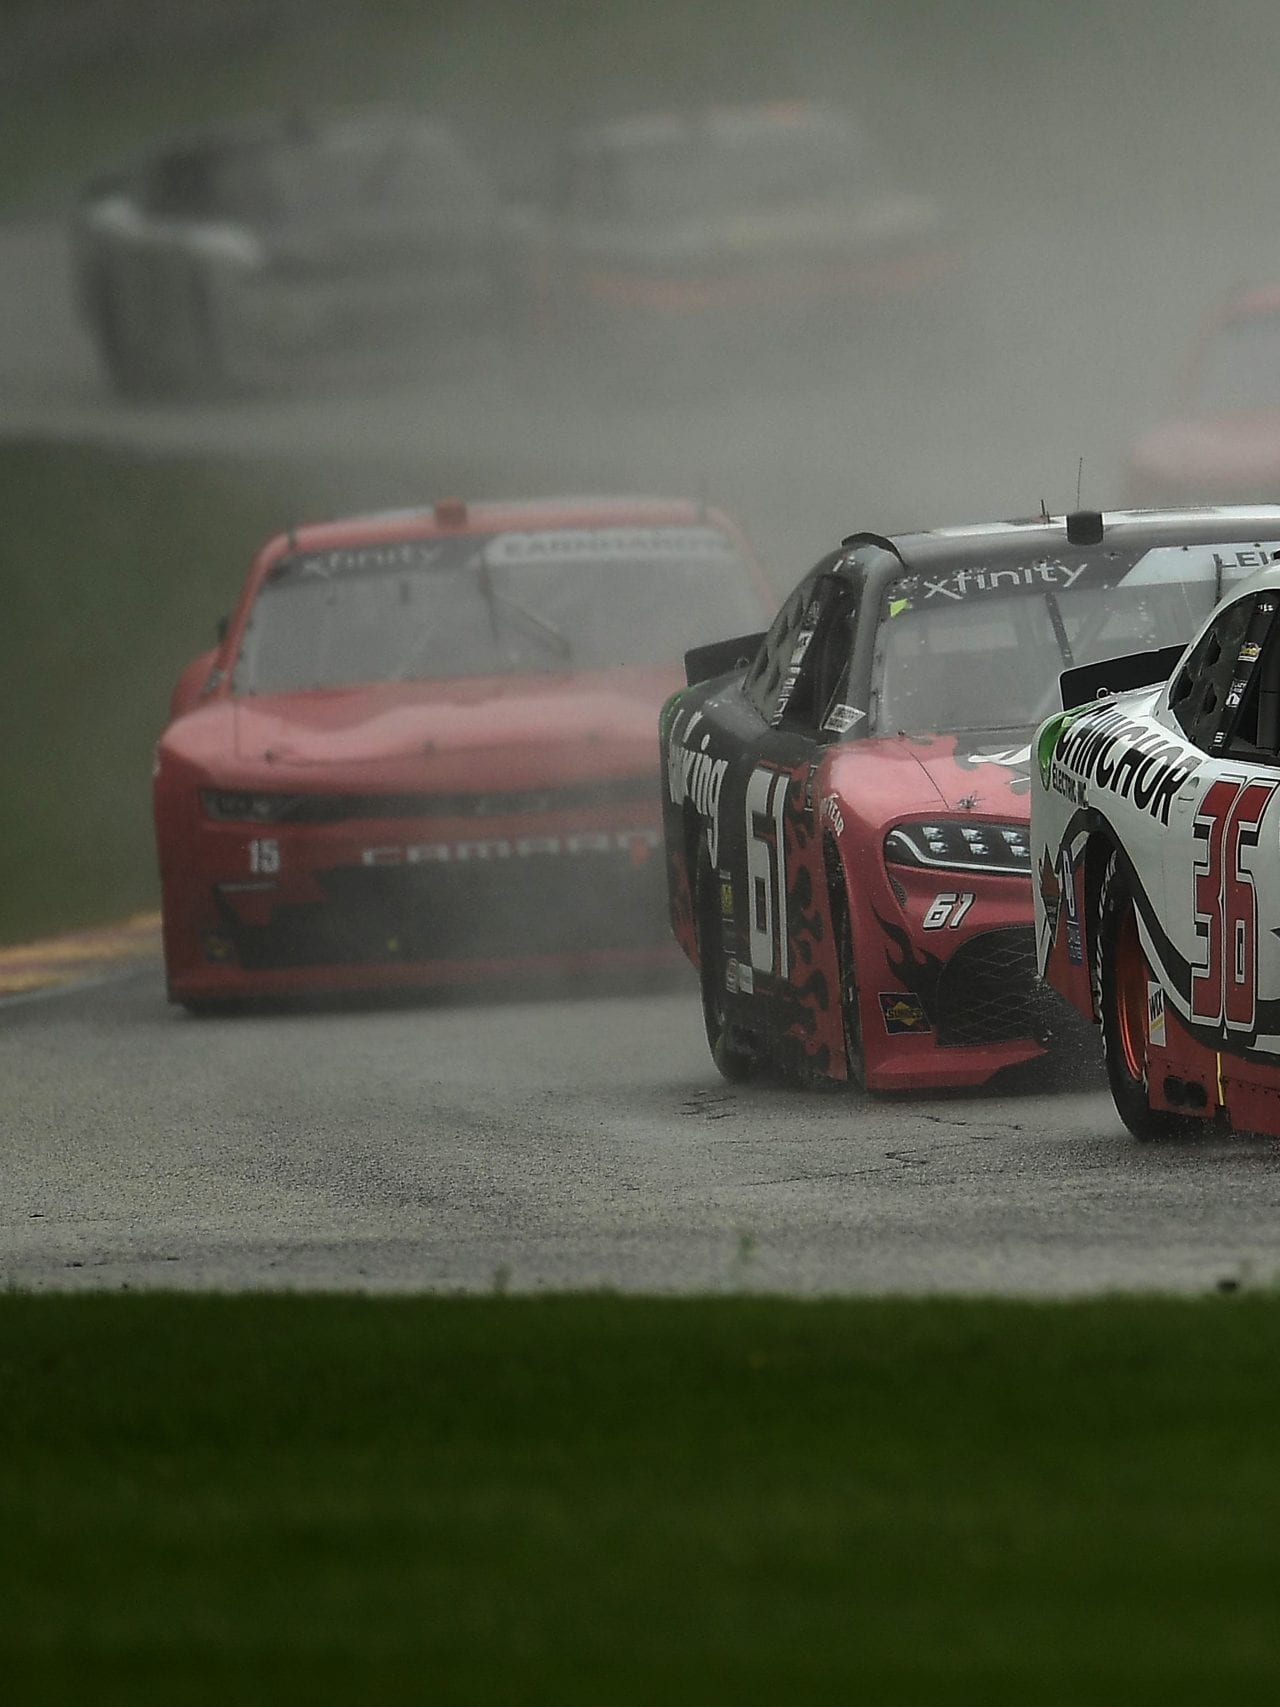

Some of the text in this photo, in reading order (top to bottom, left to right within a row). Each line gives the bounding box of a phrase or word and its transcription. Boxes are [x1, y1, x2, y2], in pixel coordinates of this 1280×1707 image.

[1213, 551, 1274, 568] LEI
[923, 560, 1089, 600] xfinity
[249, 838, 281, 873] 15
[745, 769, 790, 978] 61
[922, 892, 975, 930] 61
